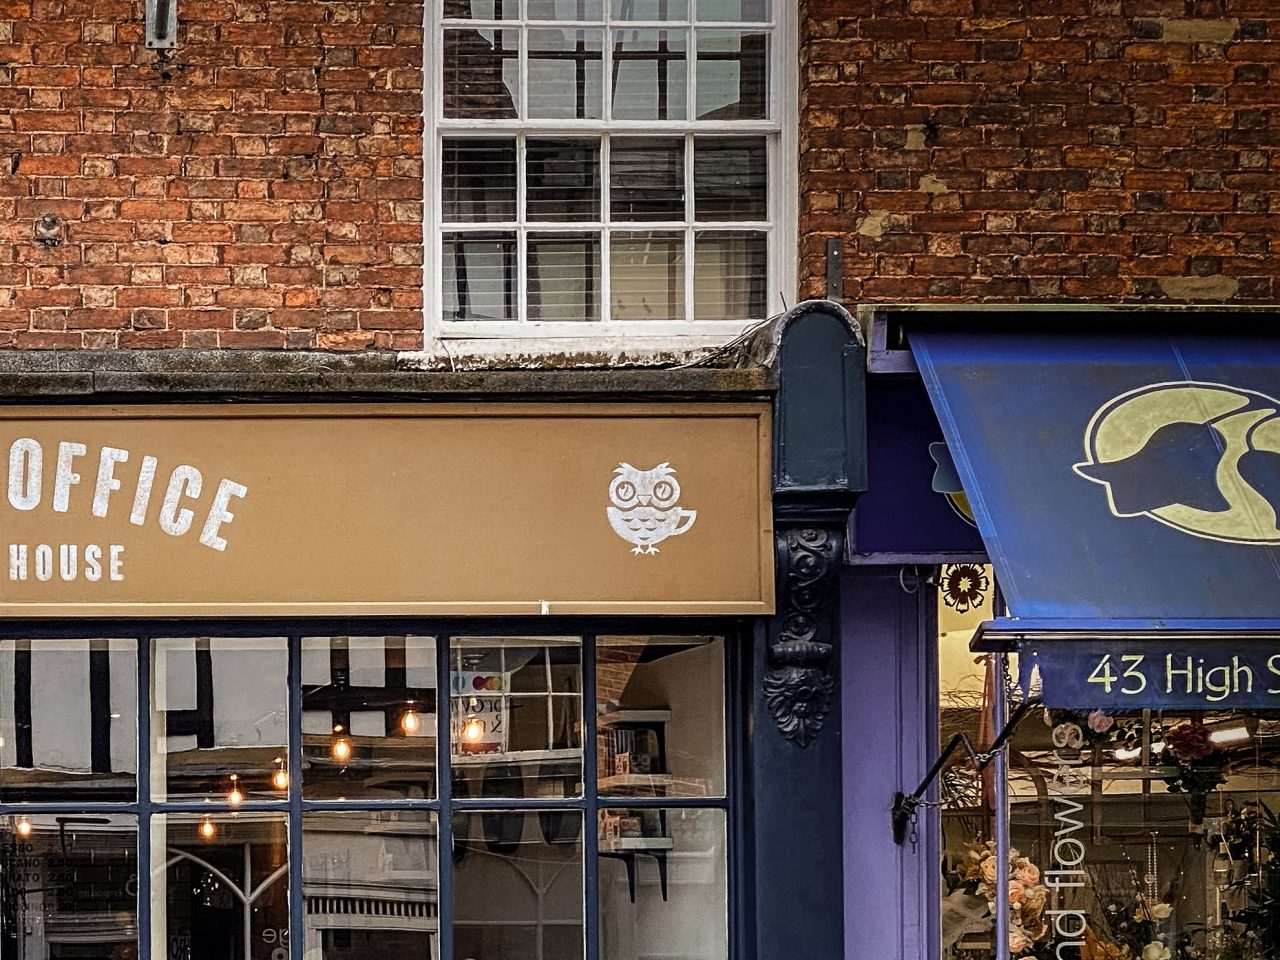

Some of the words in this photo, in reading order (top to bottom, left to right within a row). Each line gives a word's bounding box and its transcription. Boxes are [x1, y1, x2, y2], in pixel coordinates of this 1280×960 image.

[7, 437, 248, 552] OFFICE
[9, 544, 125, 582] HOUSE
[1087, 653, 1147, 695] 43
[1166, 653, 1253, 701] High
